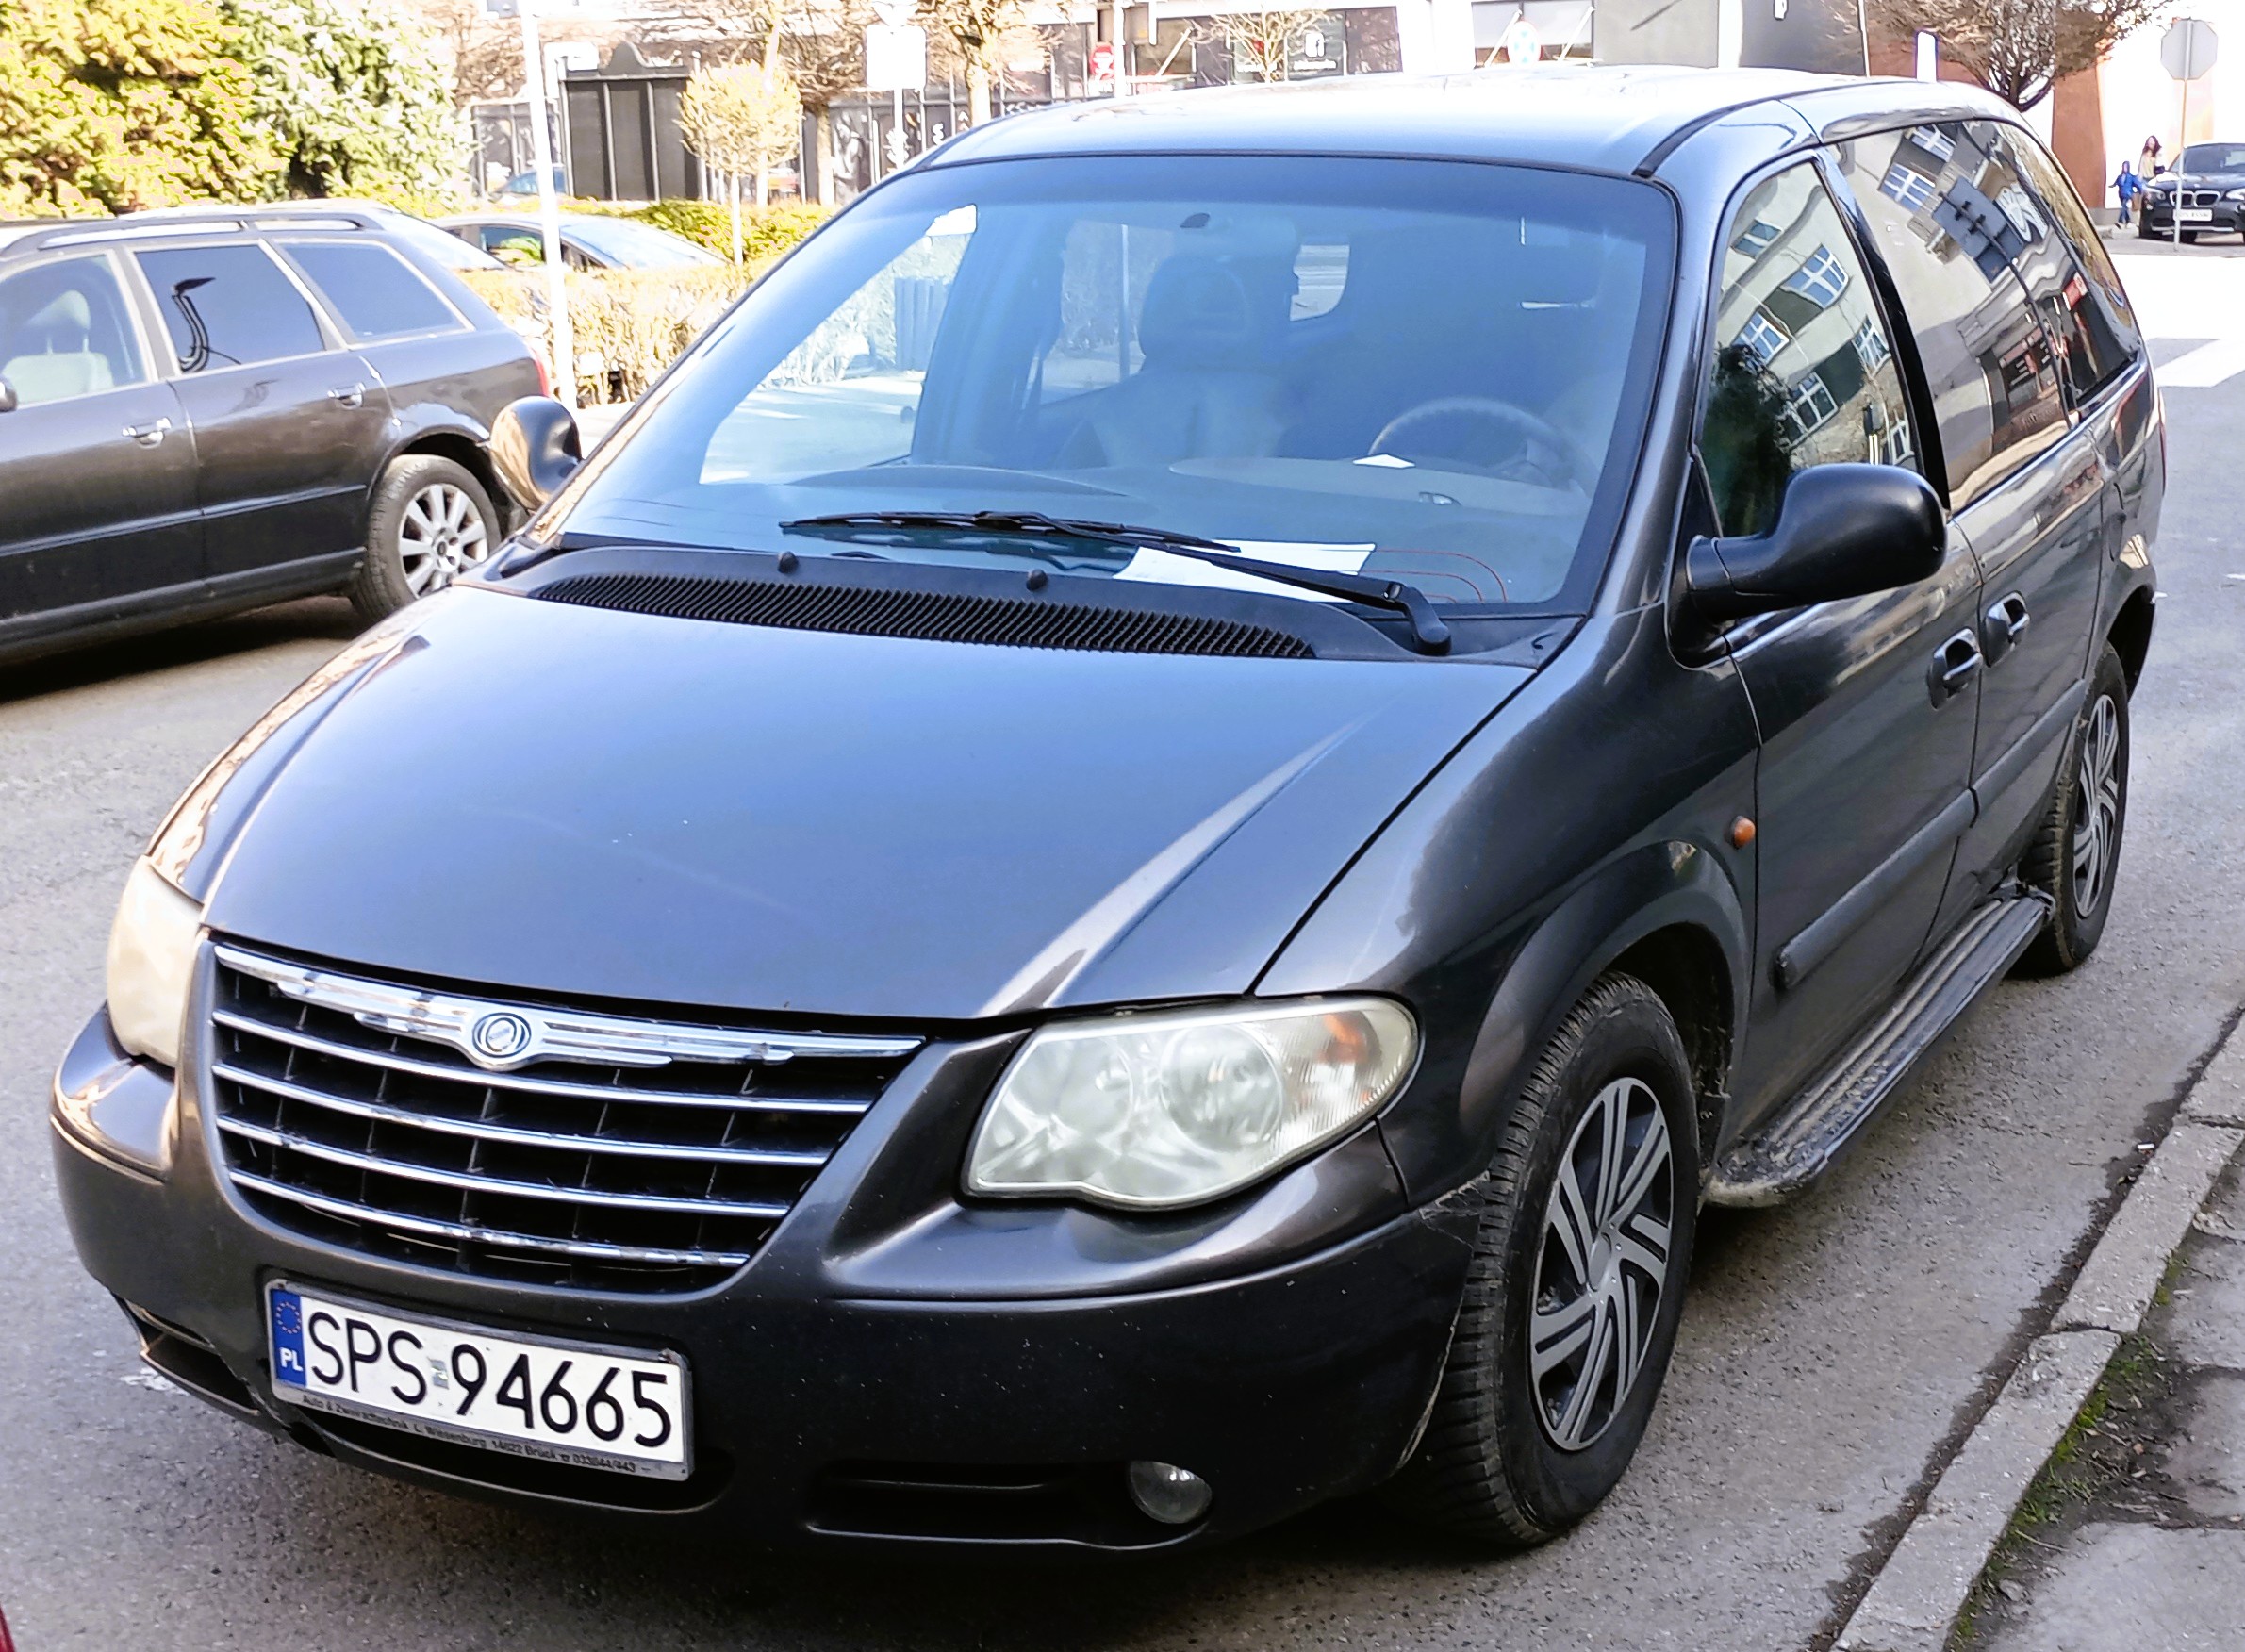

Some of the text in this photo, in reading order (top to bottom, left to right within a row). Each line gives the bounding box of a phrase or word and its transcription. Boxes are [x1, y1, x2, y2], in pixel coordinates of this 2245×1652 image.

[279, 1346, 304, 1371] PL
[308, 1311, 672, 1448] SPS 94665
